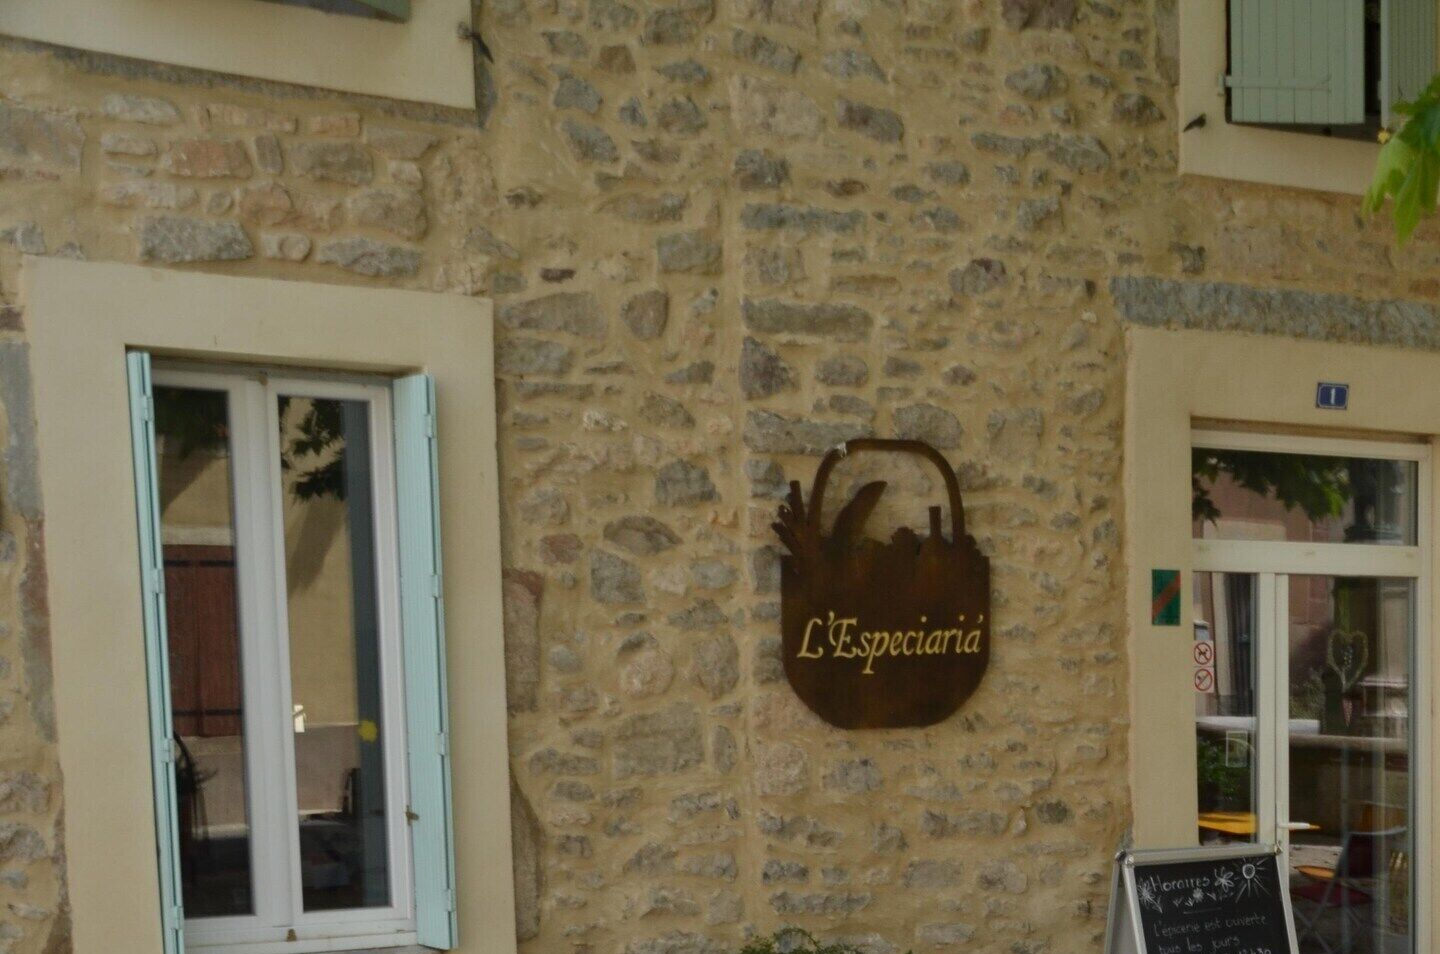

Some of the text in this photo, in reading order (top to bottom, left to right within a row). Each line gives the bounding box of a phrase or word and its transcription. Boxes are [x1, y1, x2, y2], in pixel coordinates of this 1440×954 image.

[1150, 874, 1210, 893] Horaires
[1205, 916, 1221, 931] est
[1186, 936, 1204, 952] les
[1211, 935, 1241, 954] jours
